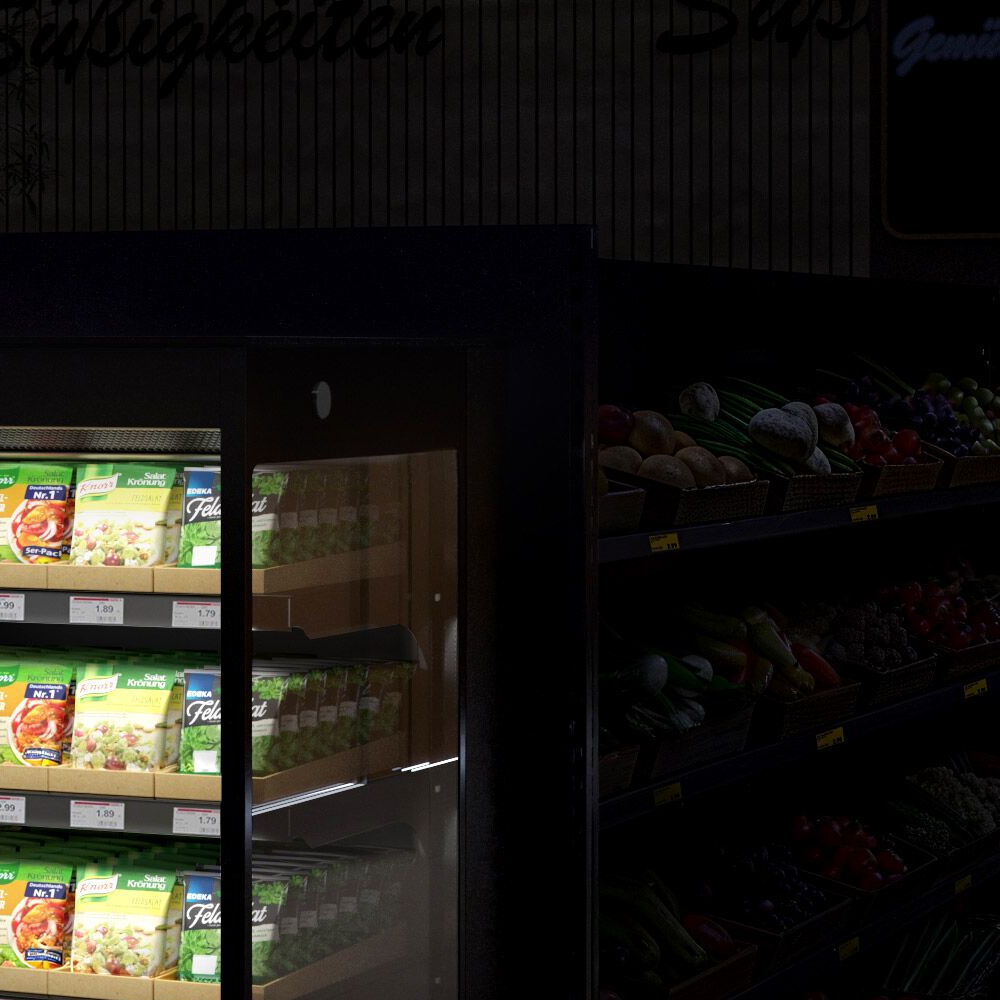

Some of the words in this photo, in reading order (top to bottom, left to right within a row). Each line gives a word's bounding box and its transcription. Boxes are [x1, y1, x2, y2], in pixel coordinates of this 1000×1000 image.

[144, 472, 166, 480] Salat
[127, 478, 166, 487] Krönung
[96, 605, 114, 613] 1.89
[198, 609, 216, 618] 1.79
[128, 679, 166, 688] Krönung
[187, 690, 212, 698] EDEKA
[96, 810, 114, 818] 1.89
[200, 816, 216, 824] 1.79
[144, 874, 166, 882] Salat
[128, 880, 166, 890] Krönung
